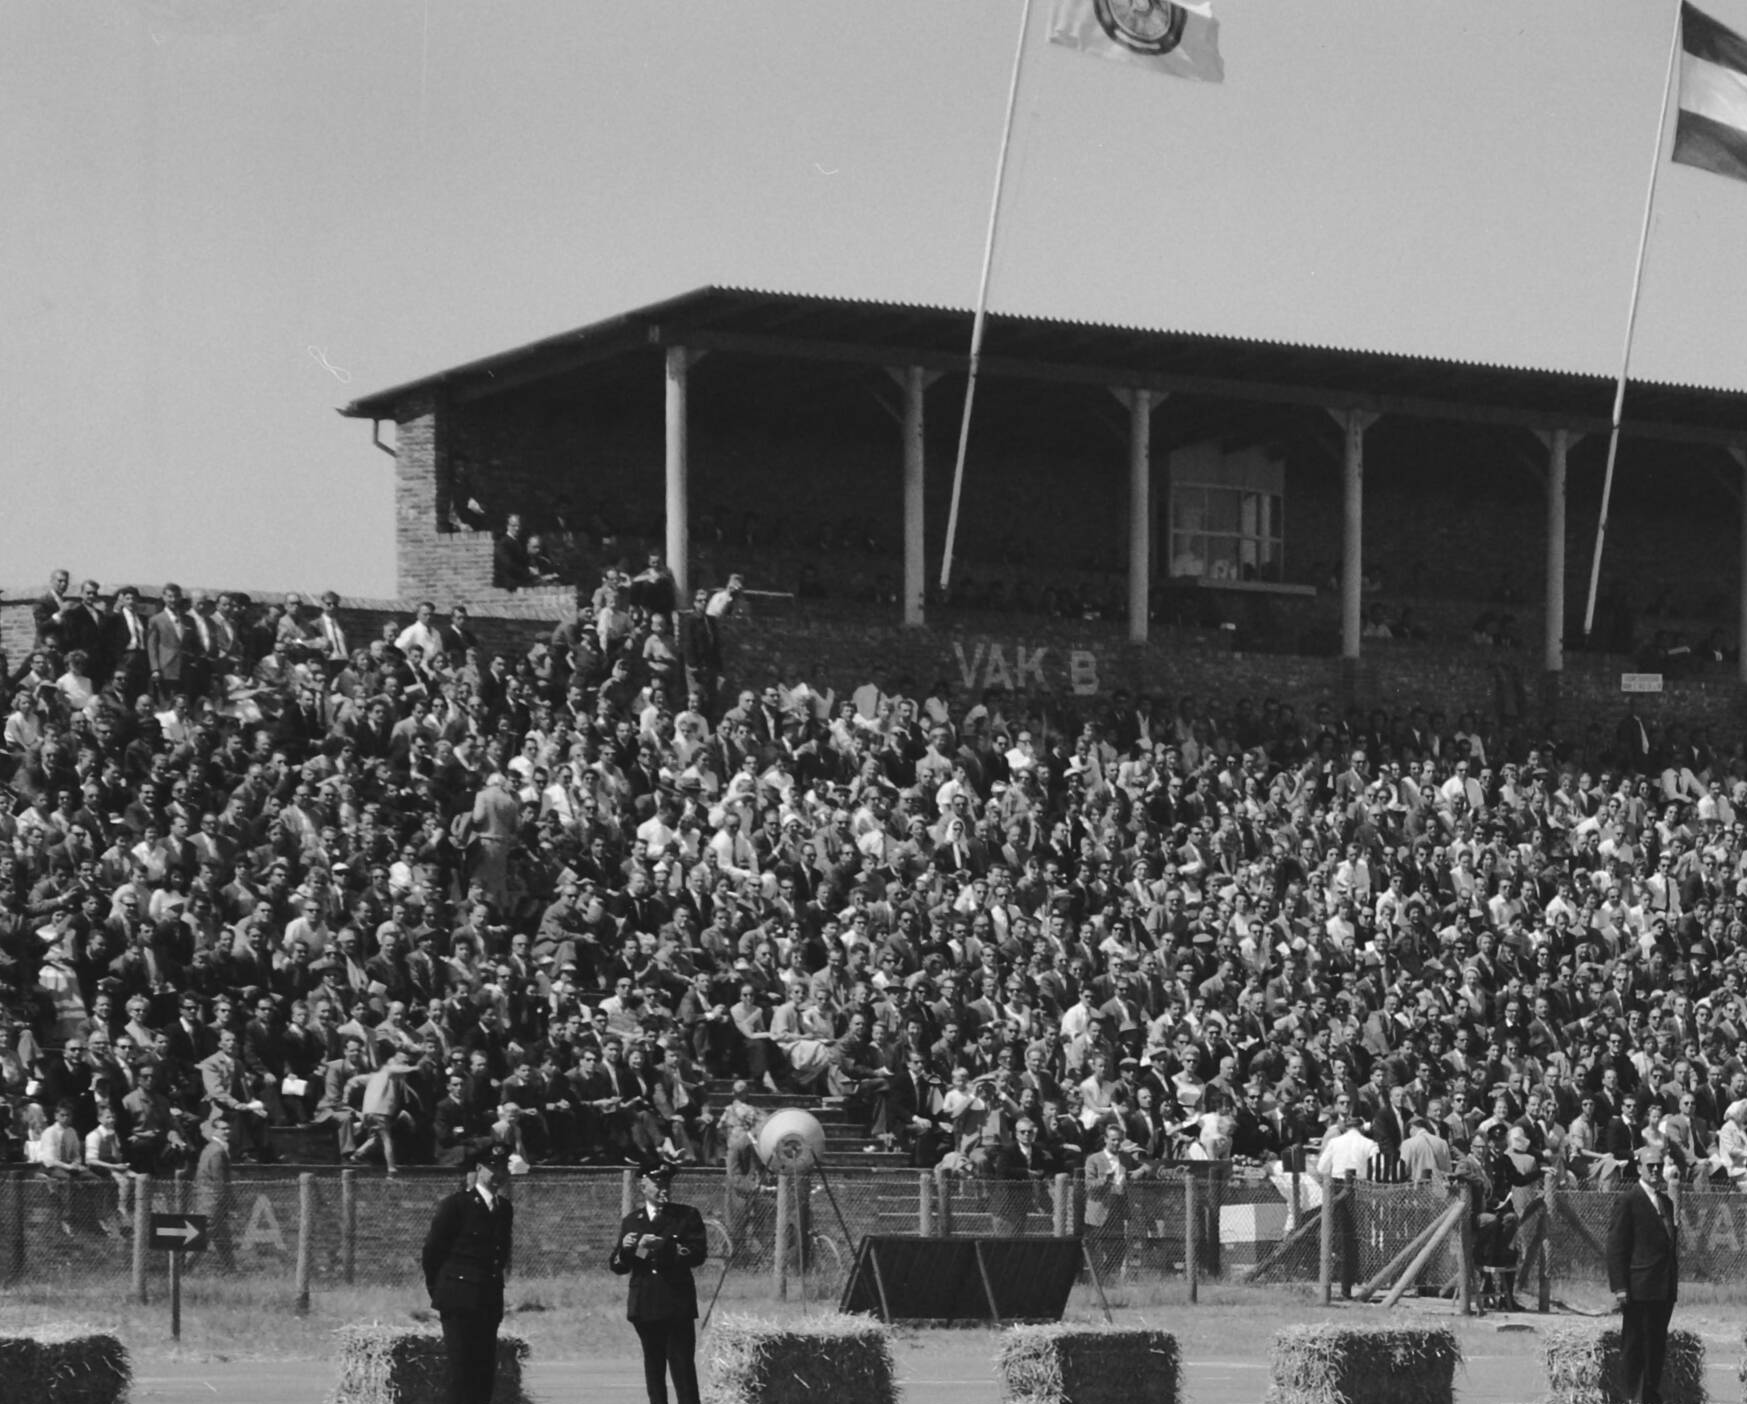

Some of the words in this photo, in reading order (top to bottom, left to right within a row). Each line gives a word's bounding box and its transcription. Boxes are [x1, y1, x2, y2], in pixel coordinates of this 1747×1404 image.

[952, 641, 1051, 692] VAK
[1070, 650, 1100, 696] B
[239, 1193, 288, 1251] A
